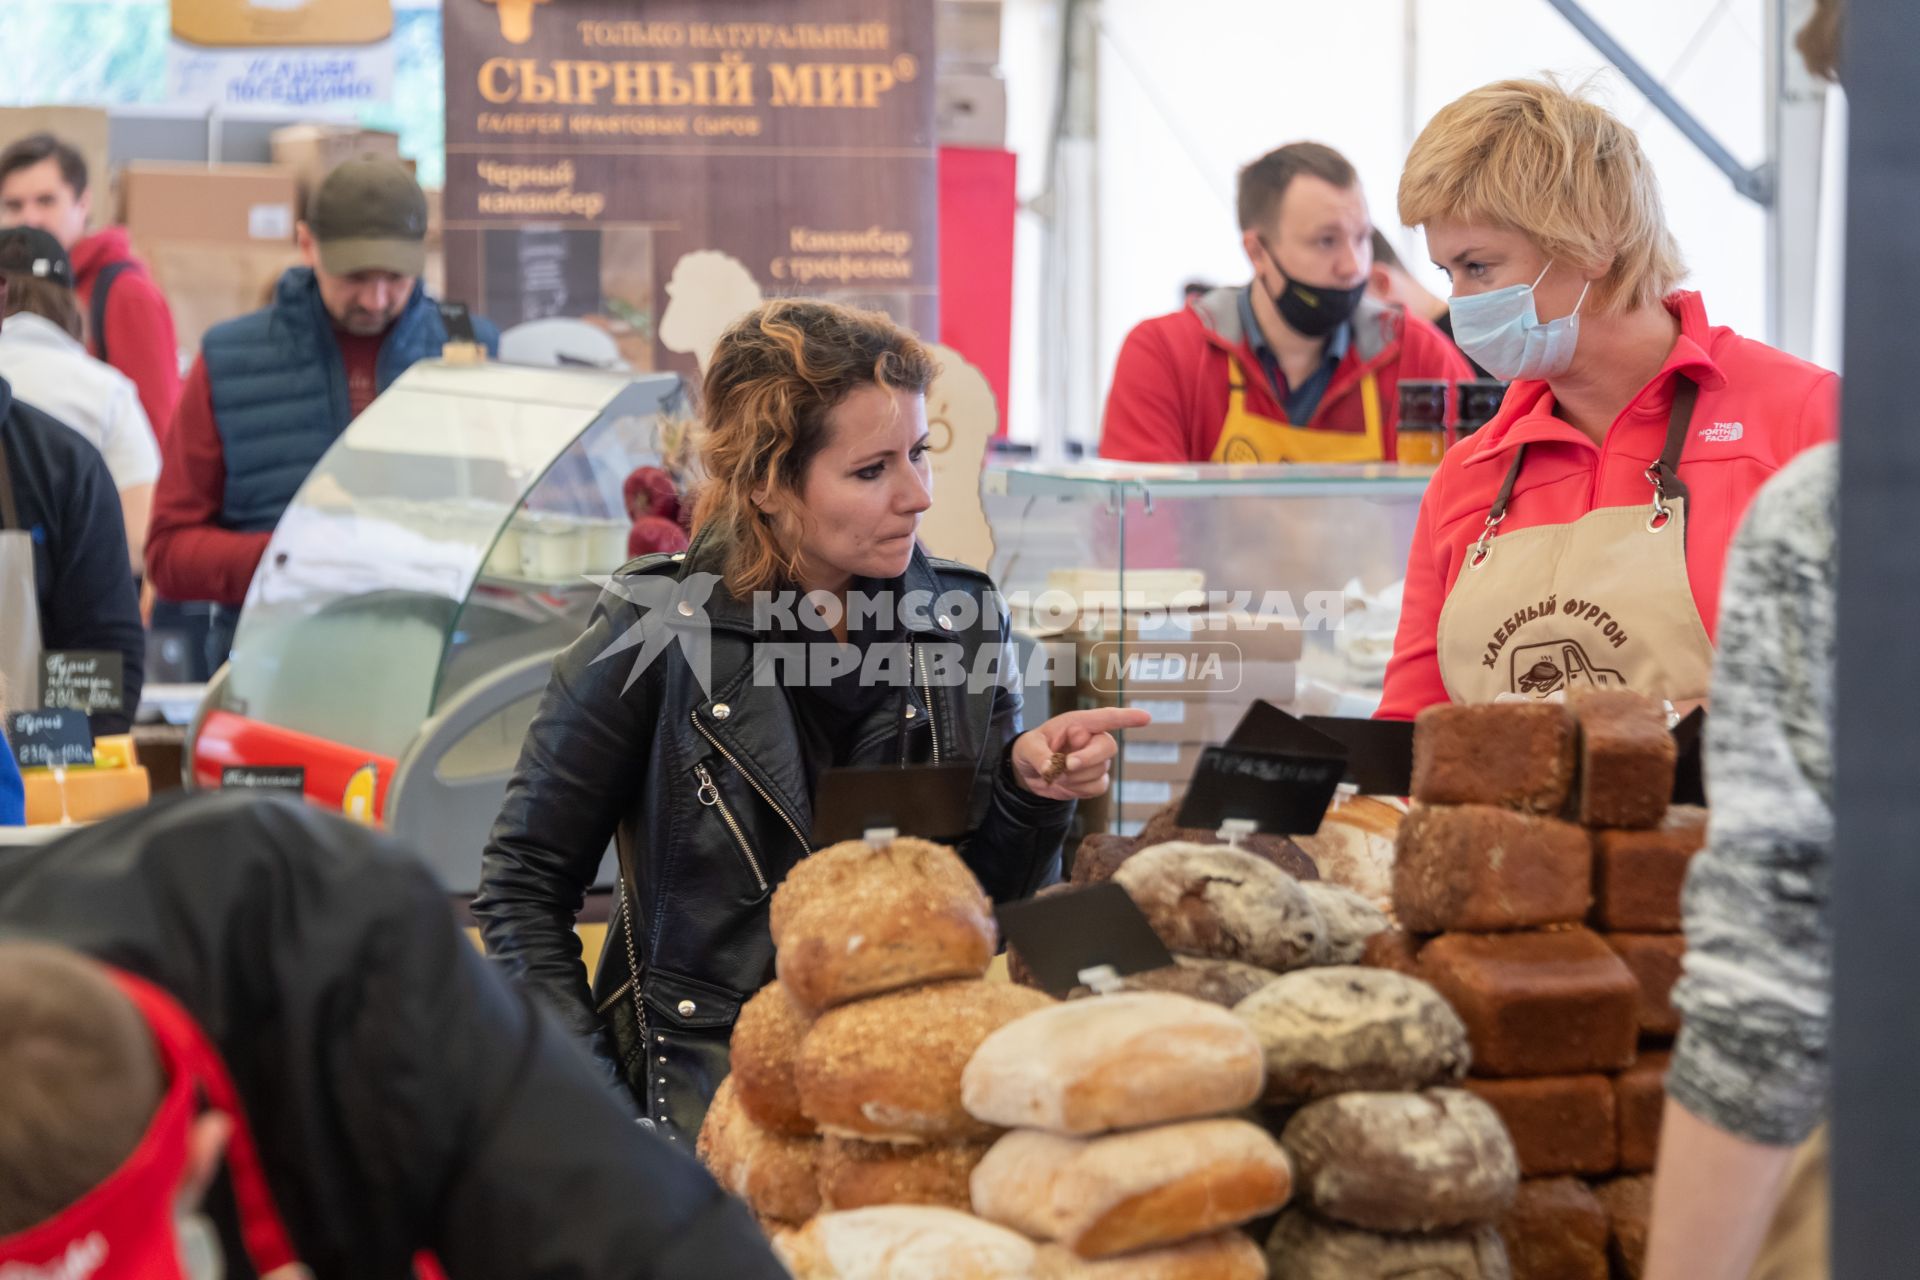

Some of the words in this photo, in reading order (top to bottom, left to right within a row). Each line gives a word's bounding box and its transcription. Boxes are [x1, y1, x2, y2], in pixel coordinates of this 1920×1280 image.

[578, 20, 682, 47] ТОЛЬКО
[689, 20, 890, 50] НАТУРАЛЬНЫЙ
[477, 51, 755, 105] СЫРНЫЙ
[477, 160, 575, 191] Черный
[790, 226, 912, 256] Камамбер
[1699, 428, 1731, 436] NORTH
[1482, 594, 1557, 670] ХЛЕБНЫЙ
[1562, 598, 1628, 649] ФУРГОН
